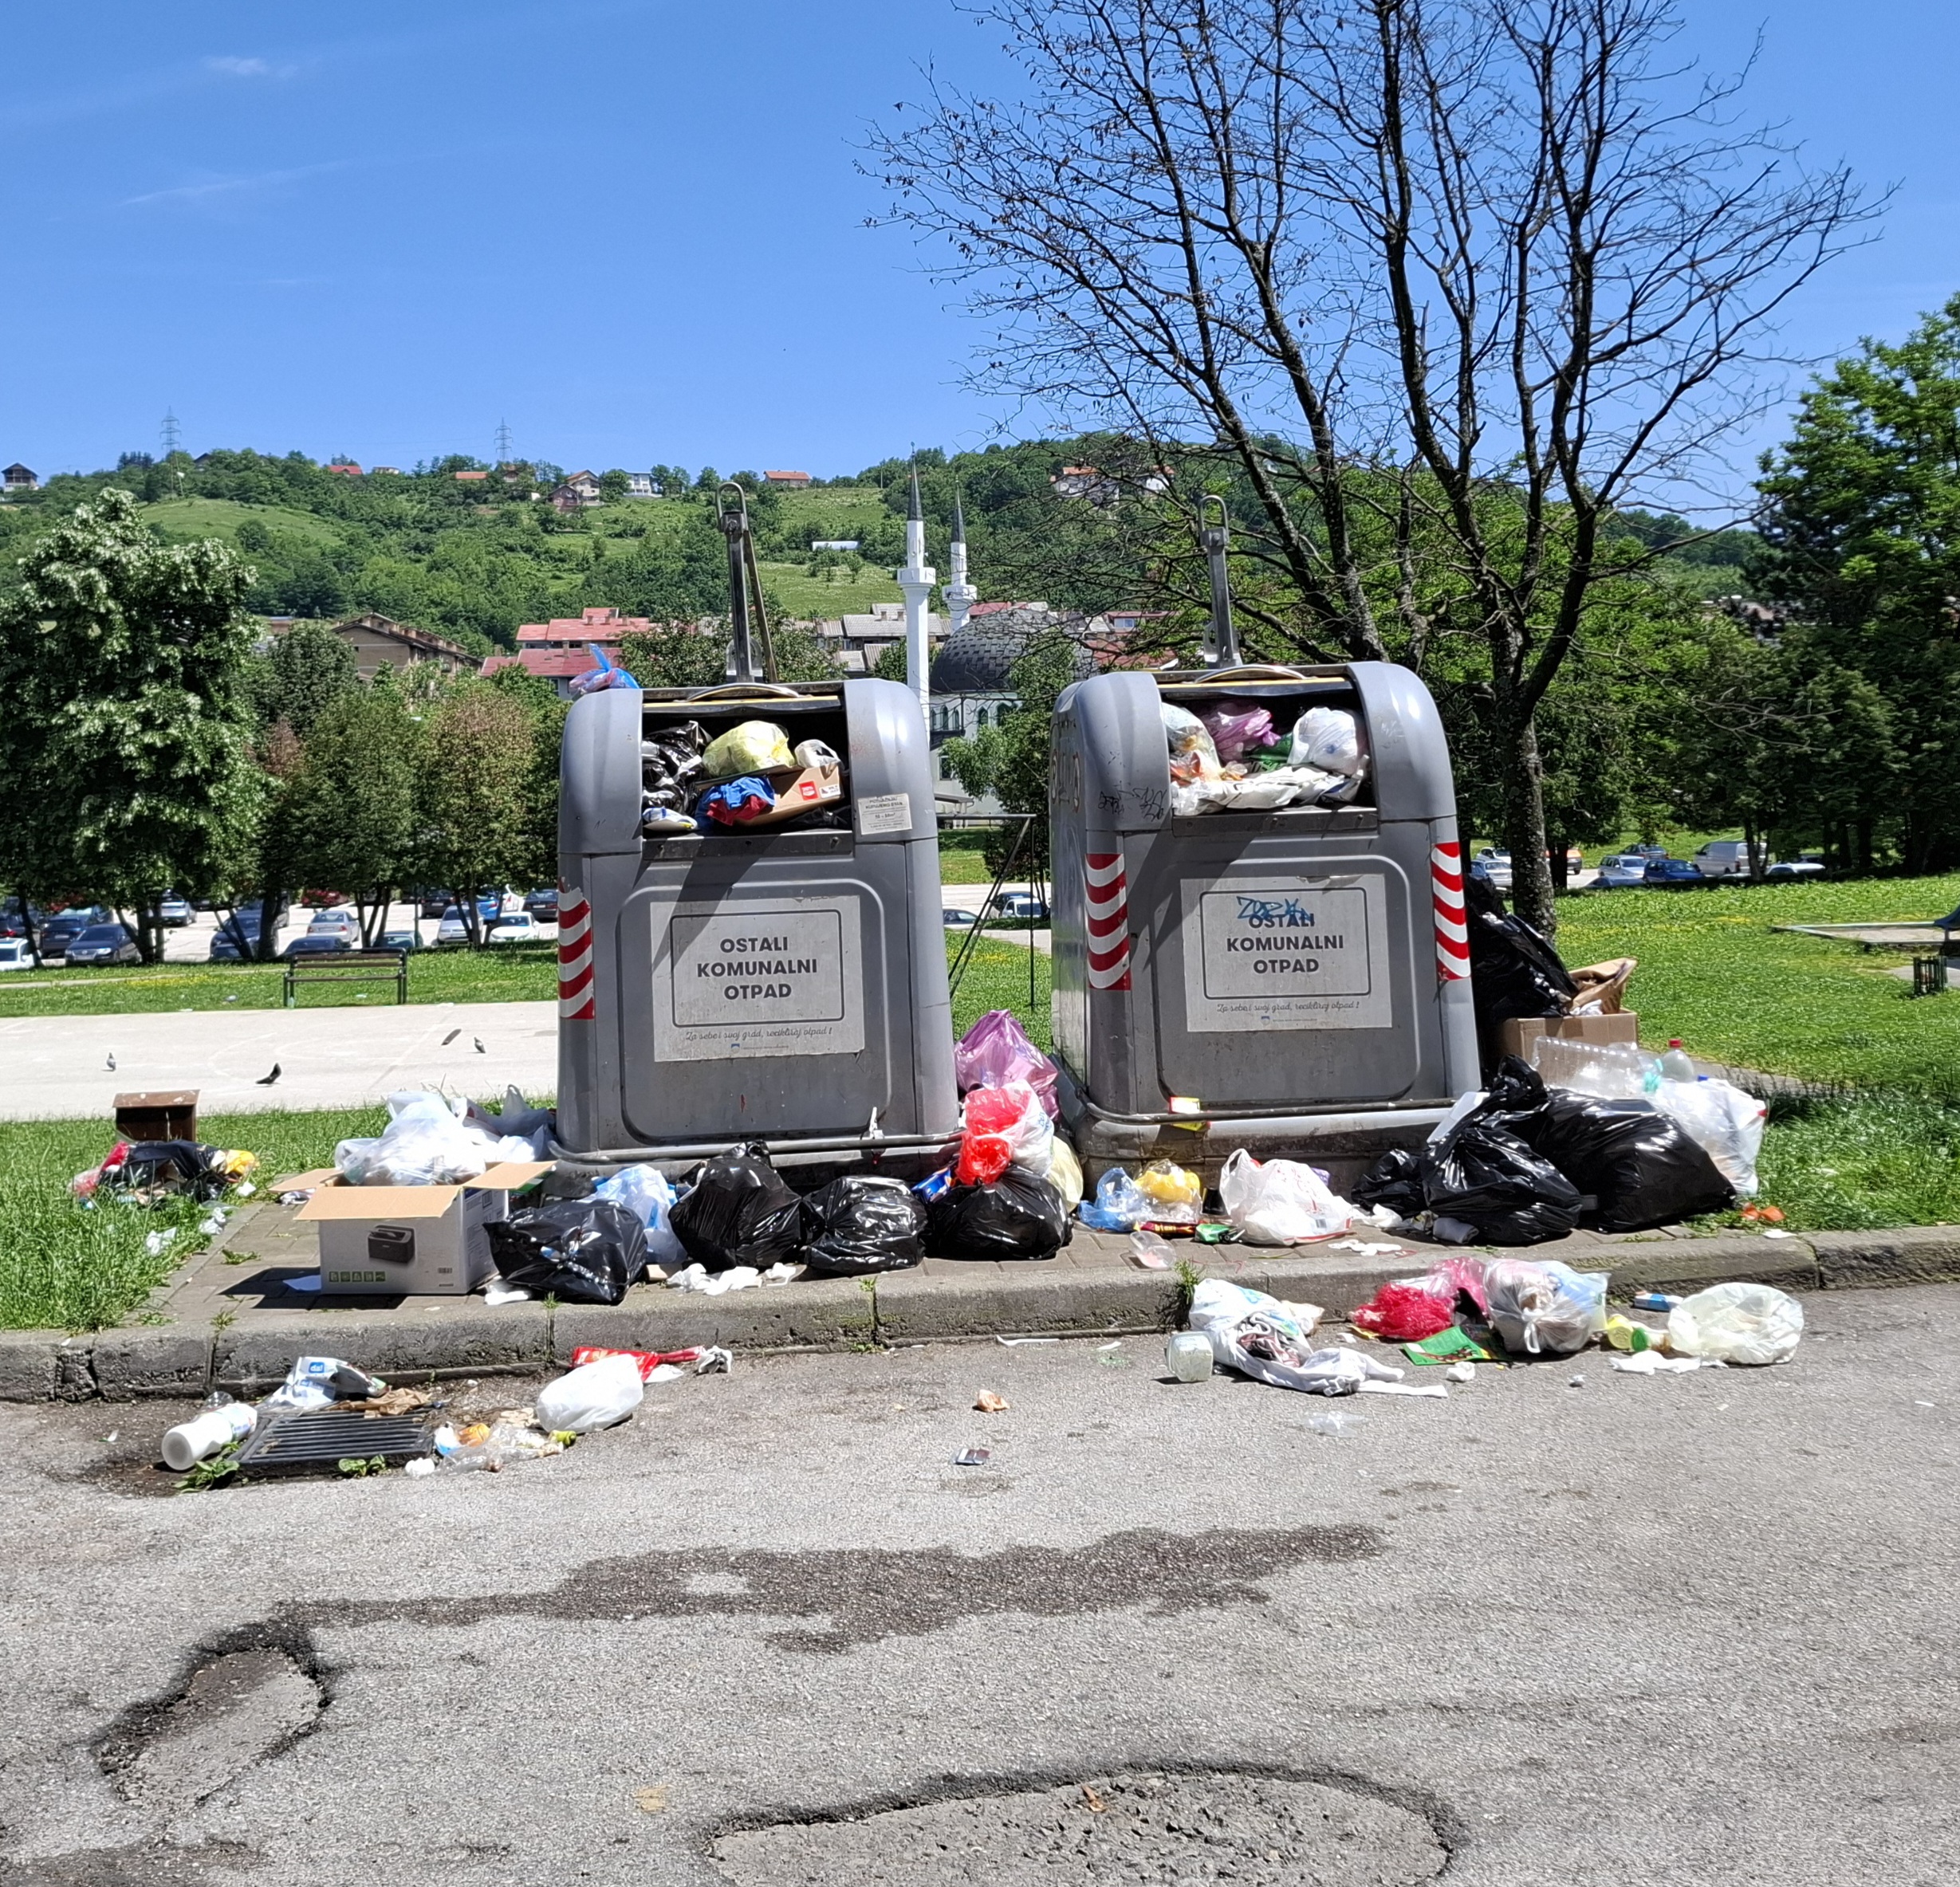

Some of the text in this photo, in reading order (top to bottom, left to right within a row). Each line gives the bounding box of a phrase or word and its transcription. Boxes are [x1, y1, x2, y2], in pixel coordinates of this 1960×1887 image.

[1249, 913, 1315, 929] OSTALI
[720, 937, 788, 953] OSTALI
[1226, 935, 1344, 952] KOMUNALNI
[697, 959, 817, 977] KOMUNALNI
[1254, 958, 1319, 974] OTPAD
[724, 983, 792, 1001] OTPAD
[686, 1032, 697, 1041] Za
[742, 1028, 764, 1041] grad,
